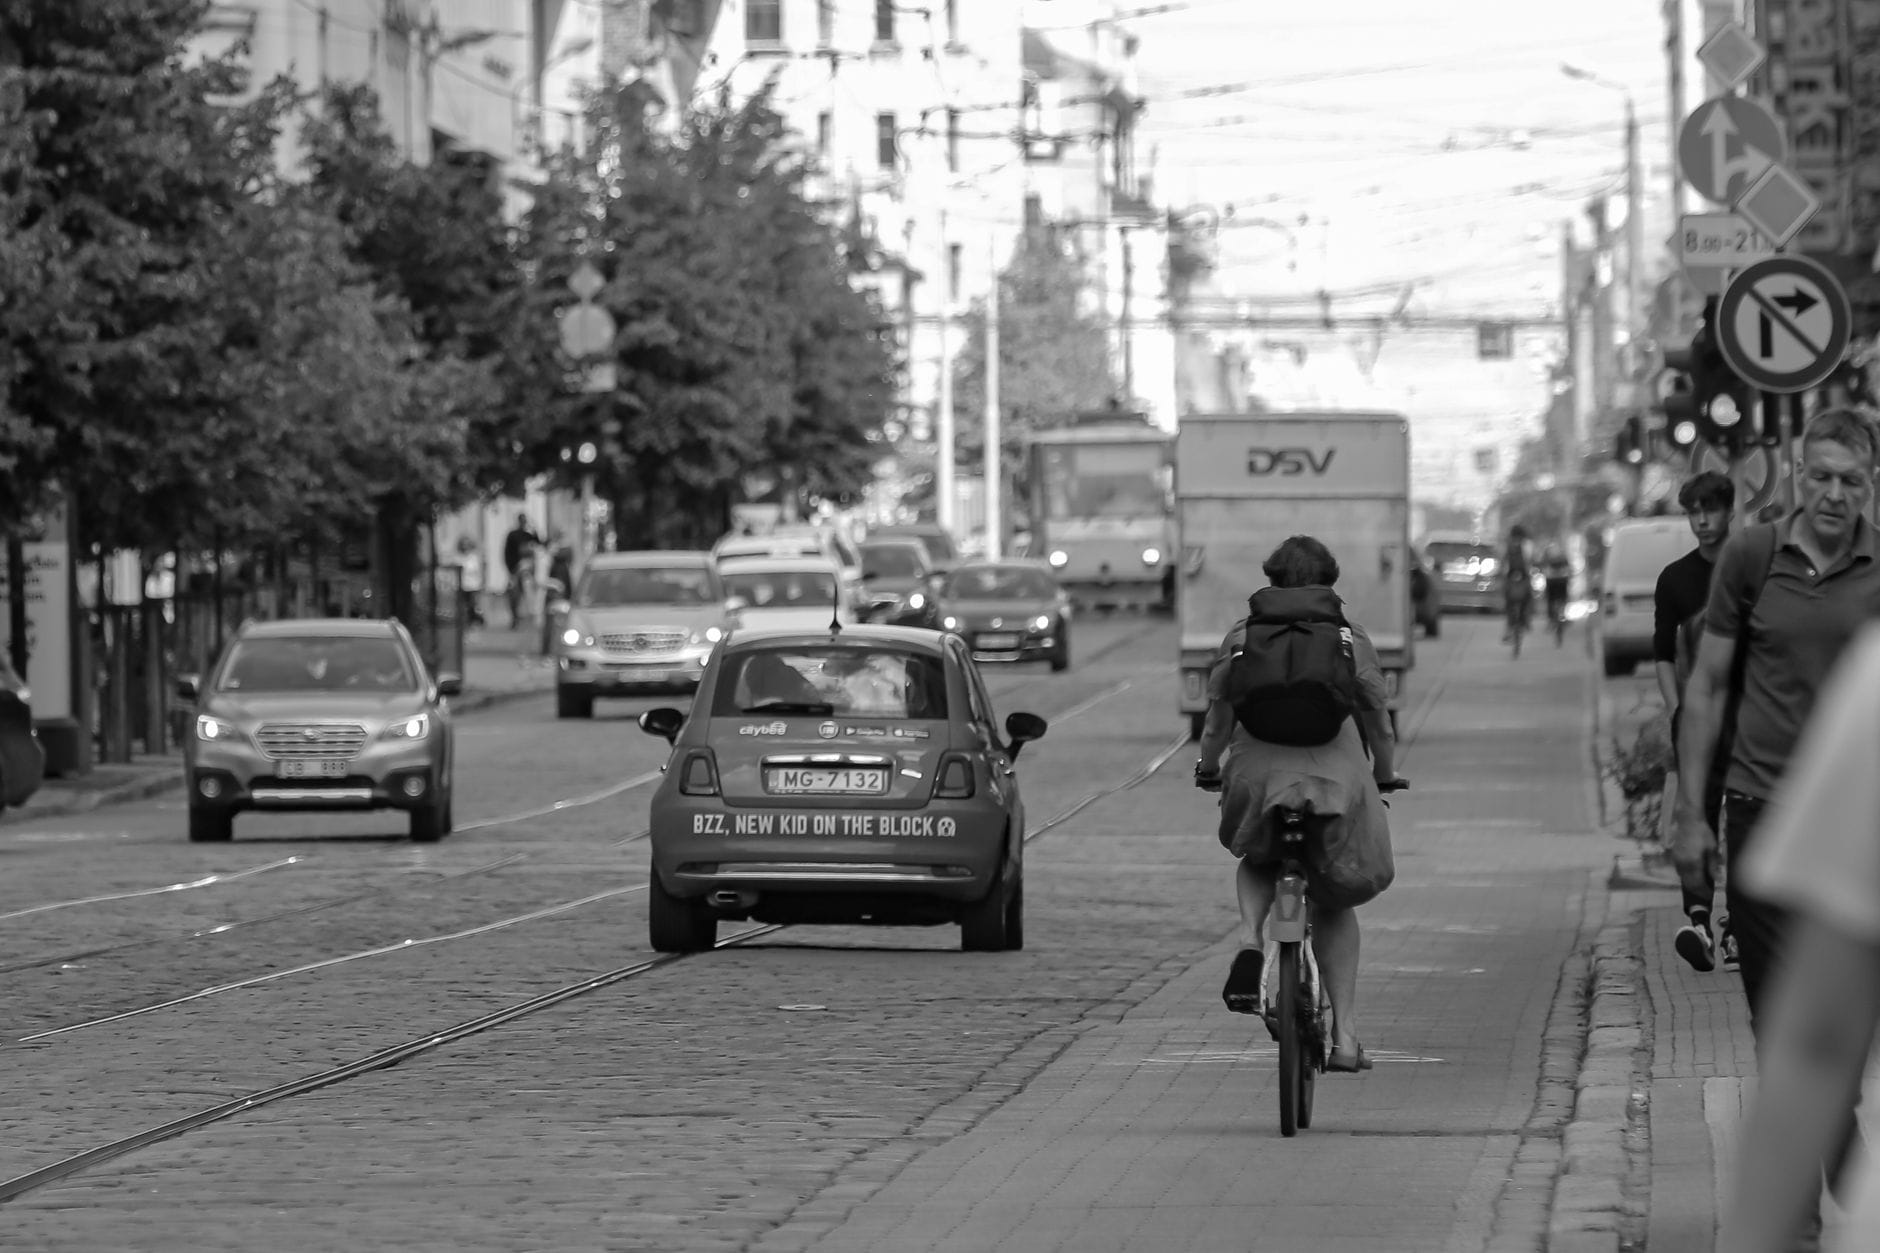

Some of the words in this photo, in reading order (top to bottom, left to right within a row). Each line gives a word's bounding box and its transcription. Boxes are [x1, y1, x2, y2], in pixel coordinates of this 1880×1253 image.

[1248, 448, 1336, 475] DSV
[739, 722, 787, 737] citybee
[784, 771, 880, 790] MG-7132
[692, 814, 730, 836] BZZ,
[735, 814, 773, 835] NEW
[779, 814, 807, 835] KID
[813, 815, 836, 836] ON
[842, 815, 874, 836] THE
[879, 816, 934, 837] BLOCK
